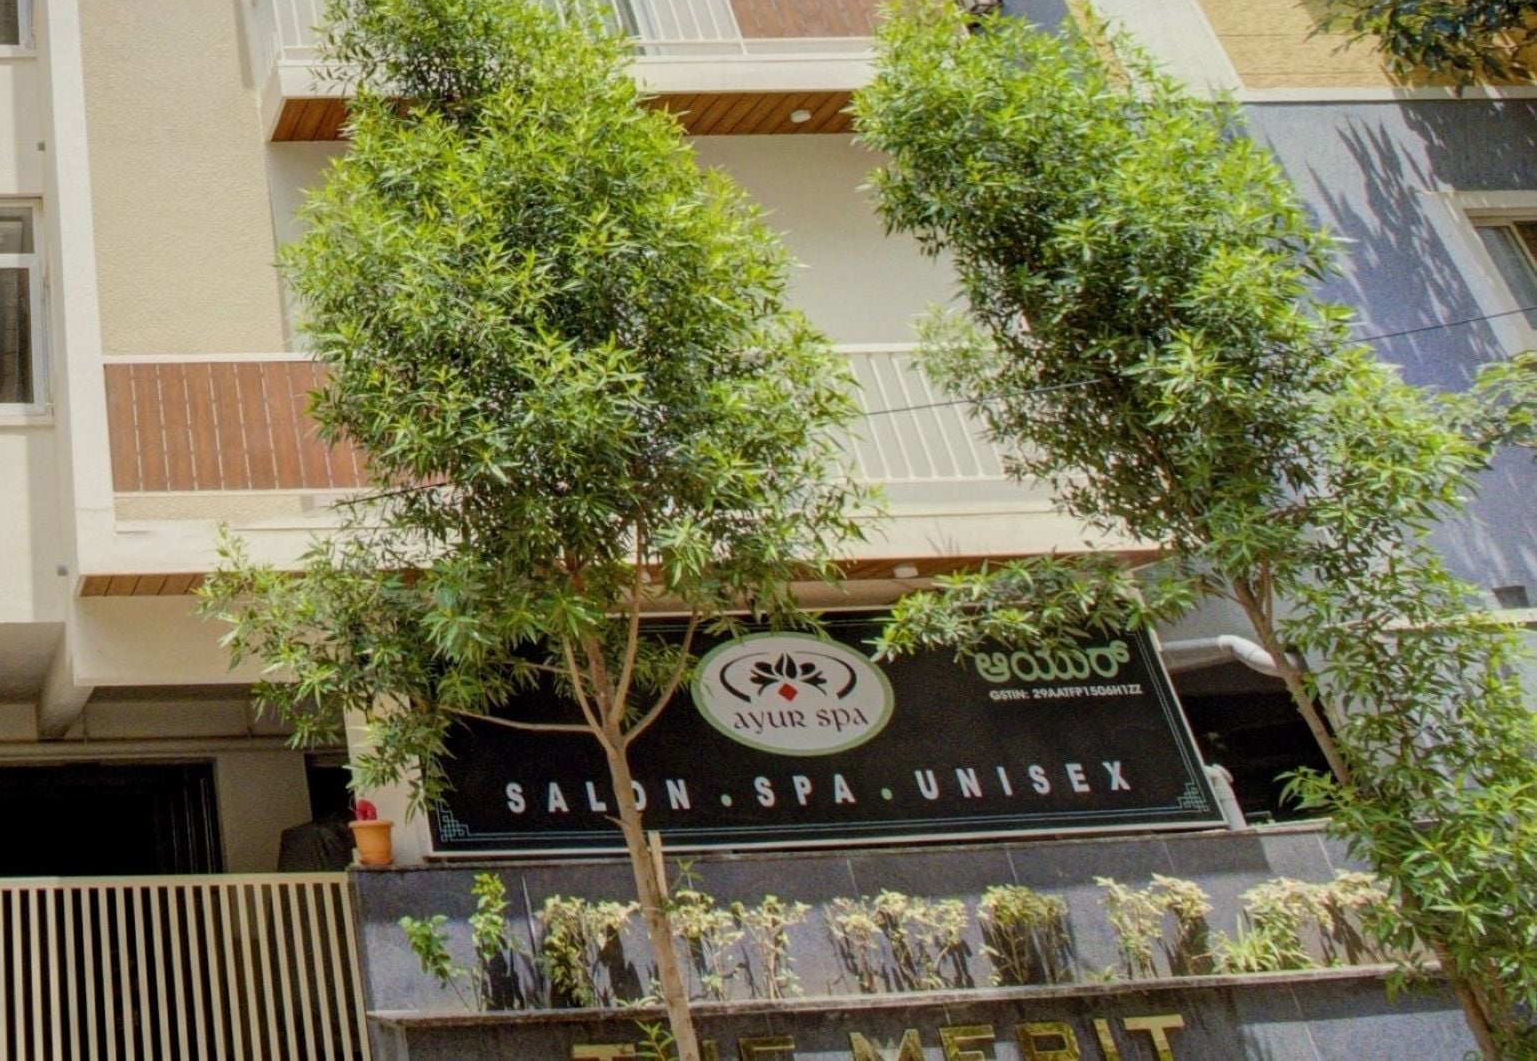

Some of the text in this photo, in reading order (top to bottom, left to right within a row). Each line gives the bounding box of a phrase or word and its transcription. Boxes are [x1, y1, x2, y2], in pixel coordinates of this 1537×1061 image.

[989, 689, 1031, 701] GSTIN:
[815, 707, 869, 732] spa
[753, 773, 856, 807] SPA
[914, 761, 1131, 801] UNISEX
